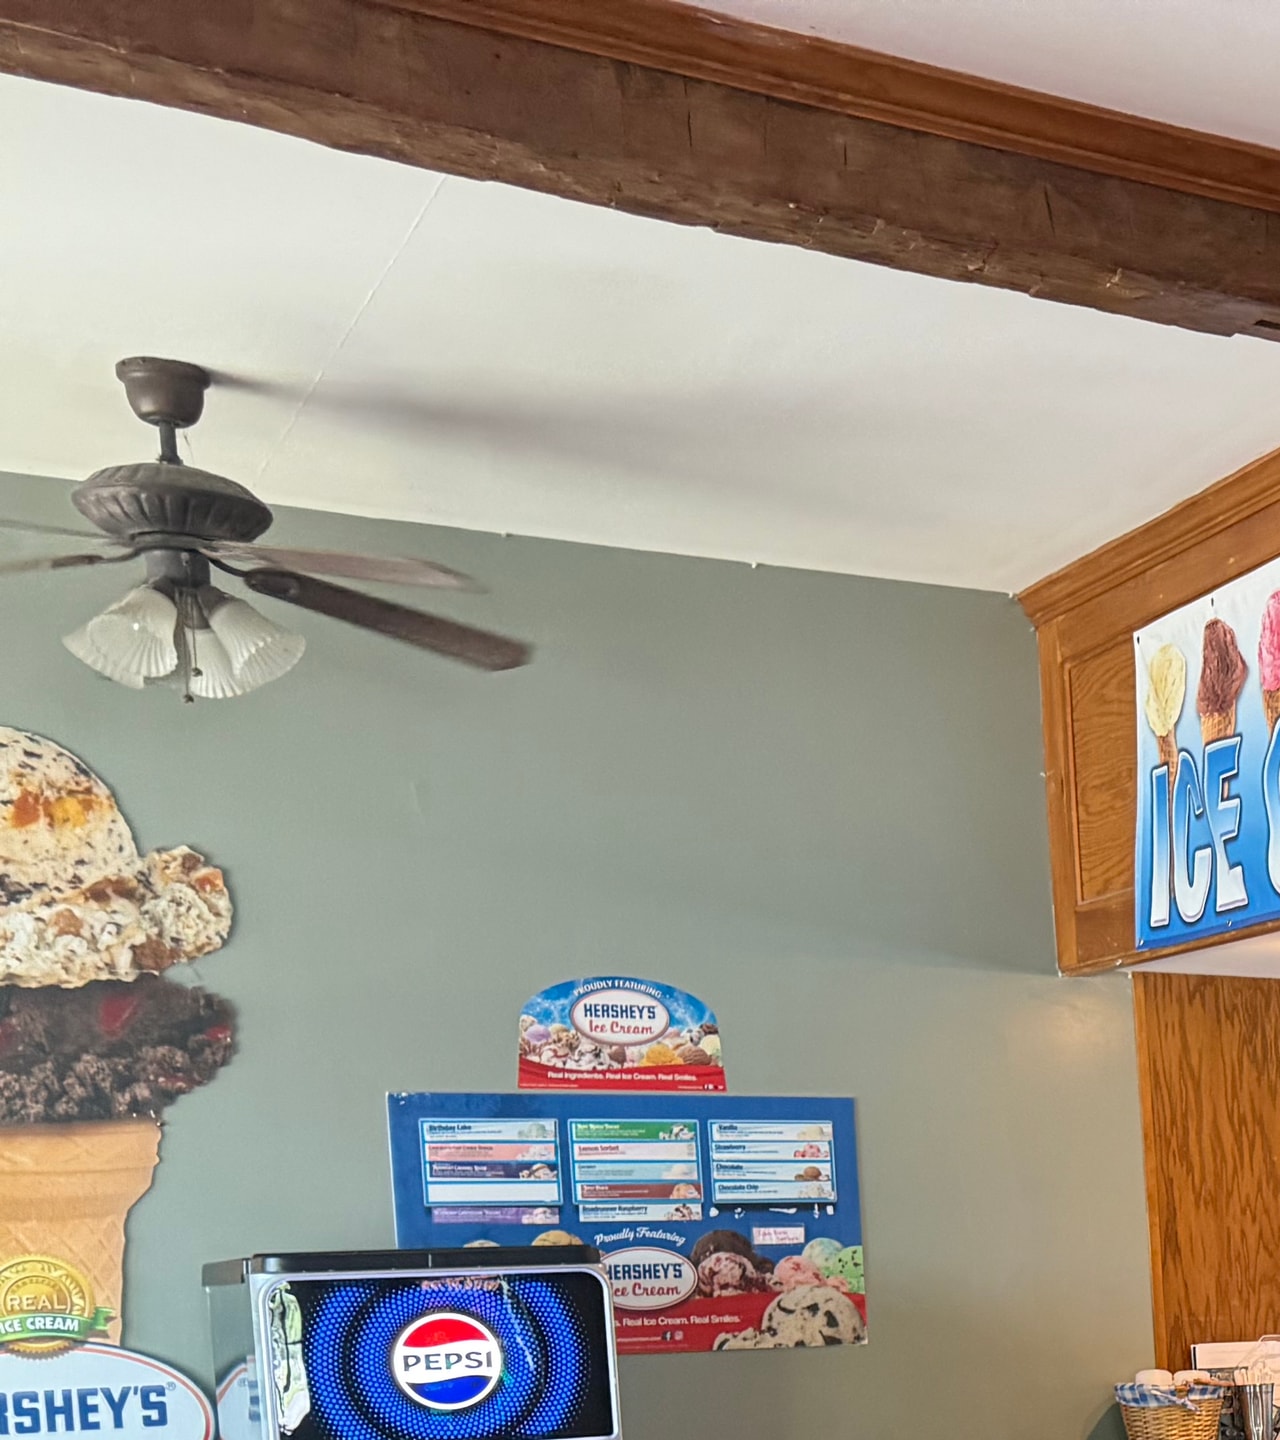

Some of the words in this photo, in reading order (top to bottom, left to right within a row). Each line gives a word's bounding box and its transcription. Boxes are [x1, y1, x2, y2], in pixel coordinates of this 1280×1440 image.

[1150, 736, 1248, 927] ICE
[573, 979, 613, 997] PROUDLY
[614, 979, 663, 998] FEATURING
[583, 1003, 657, 1020] HERSHEY'S
[588, 1019, 608, 1034] Ice
[609, 1021, 654, 1035] Cream
[594, 1228, 634, 1246] Proudly
[635, 1226, 687, 1246] Featuring
[632, 1282, 681, 1297] Cream
[7, 1293, 67, 1311] REAL
[26, 1317, 79, 1332] CREAM
[403, 1350, 493, 1372] PEPSI
